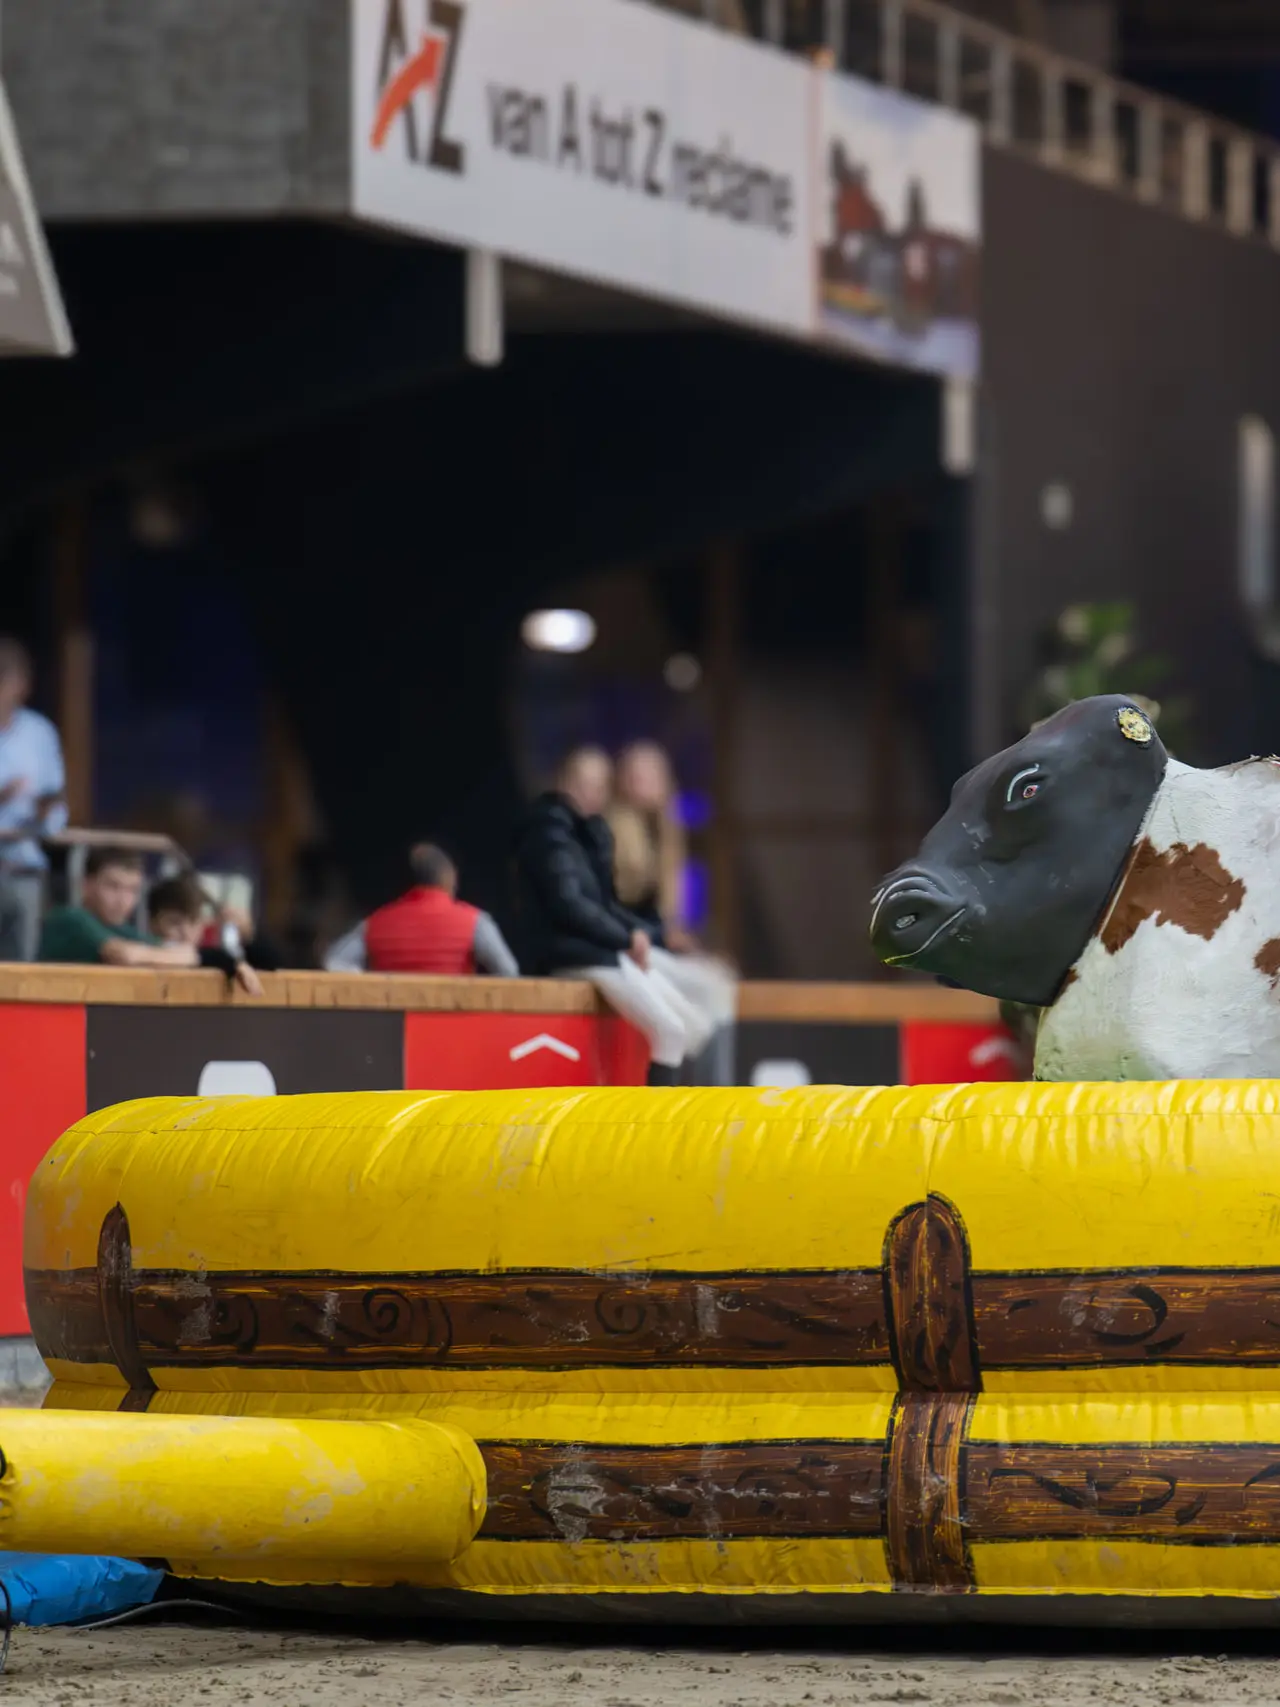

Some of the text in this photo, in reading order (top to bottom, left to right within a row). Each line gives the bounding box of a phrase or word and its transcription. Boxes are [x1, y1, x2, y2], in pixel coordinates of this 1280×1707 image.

[486, 80, 793, 235] van A tot Z reclame
